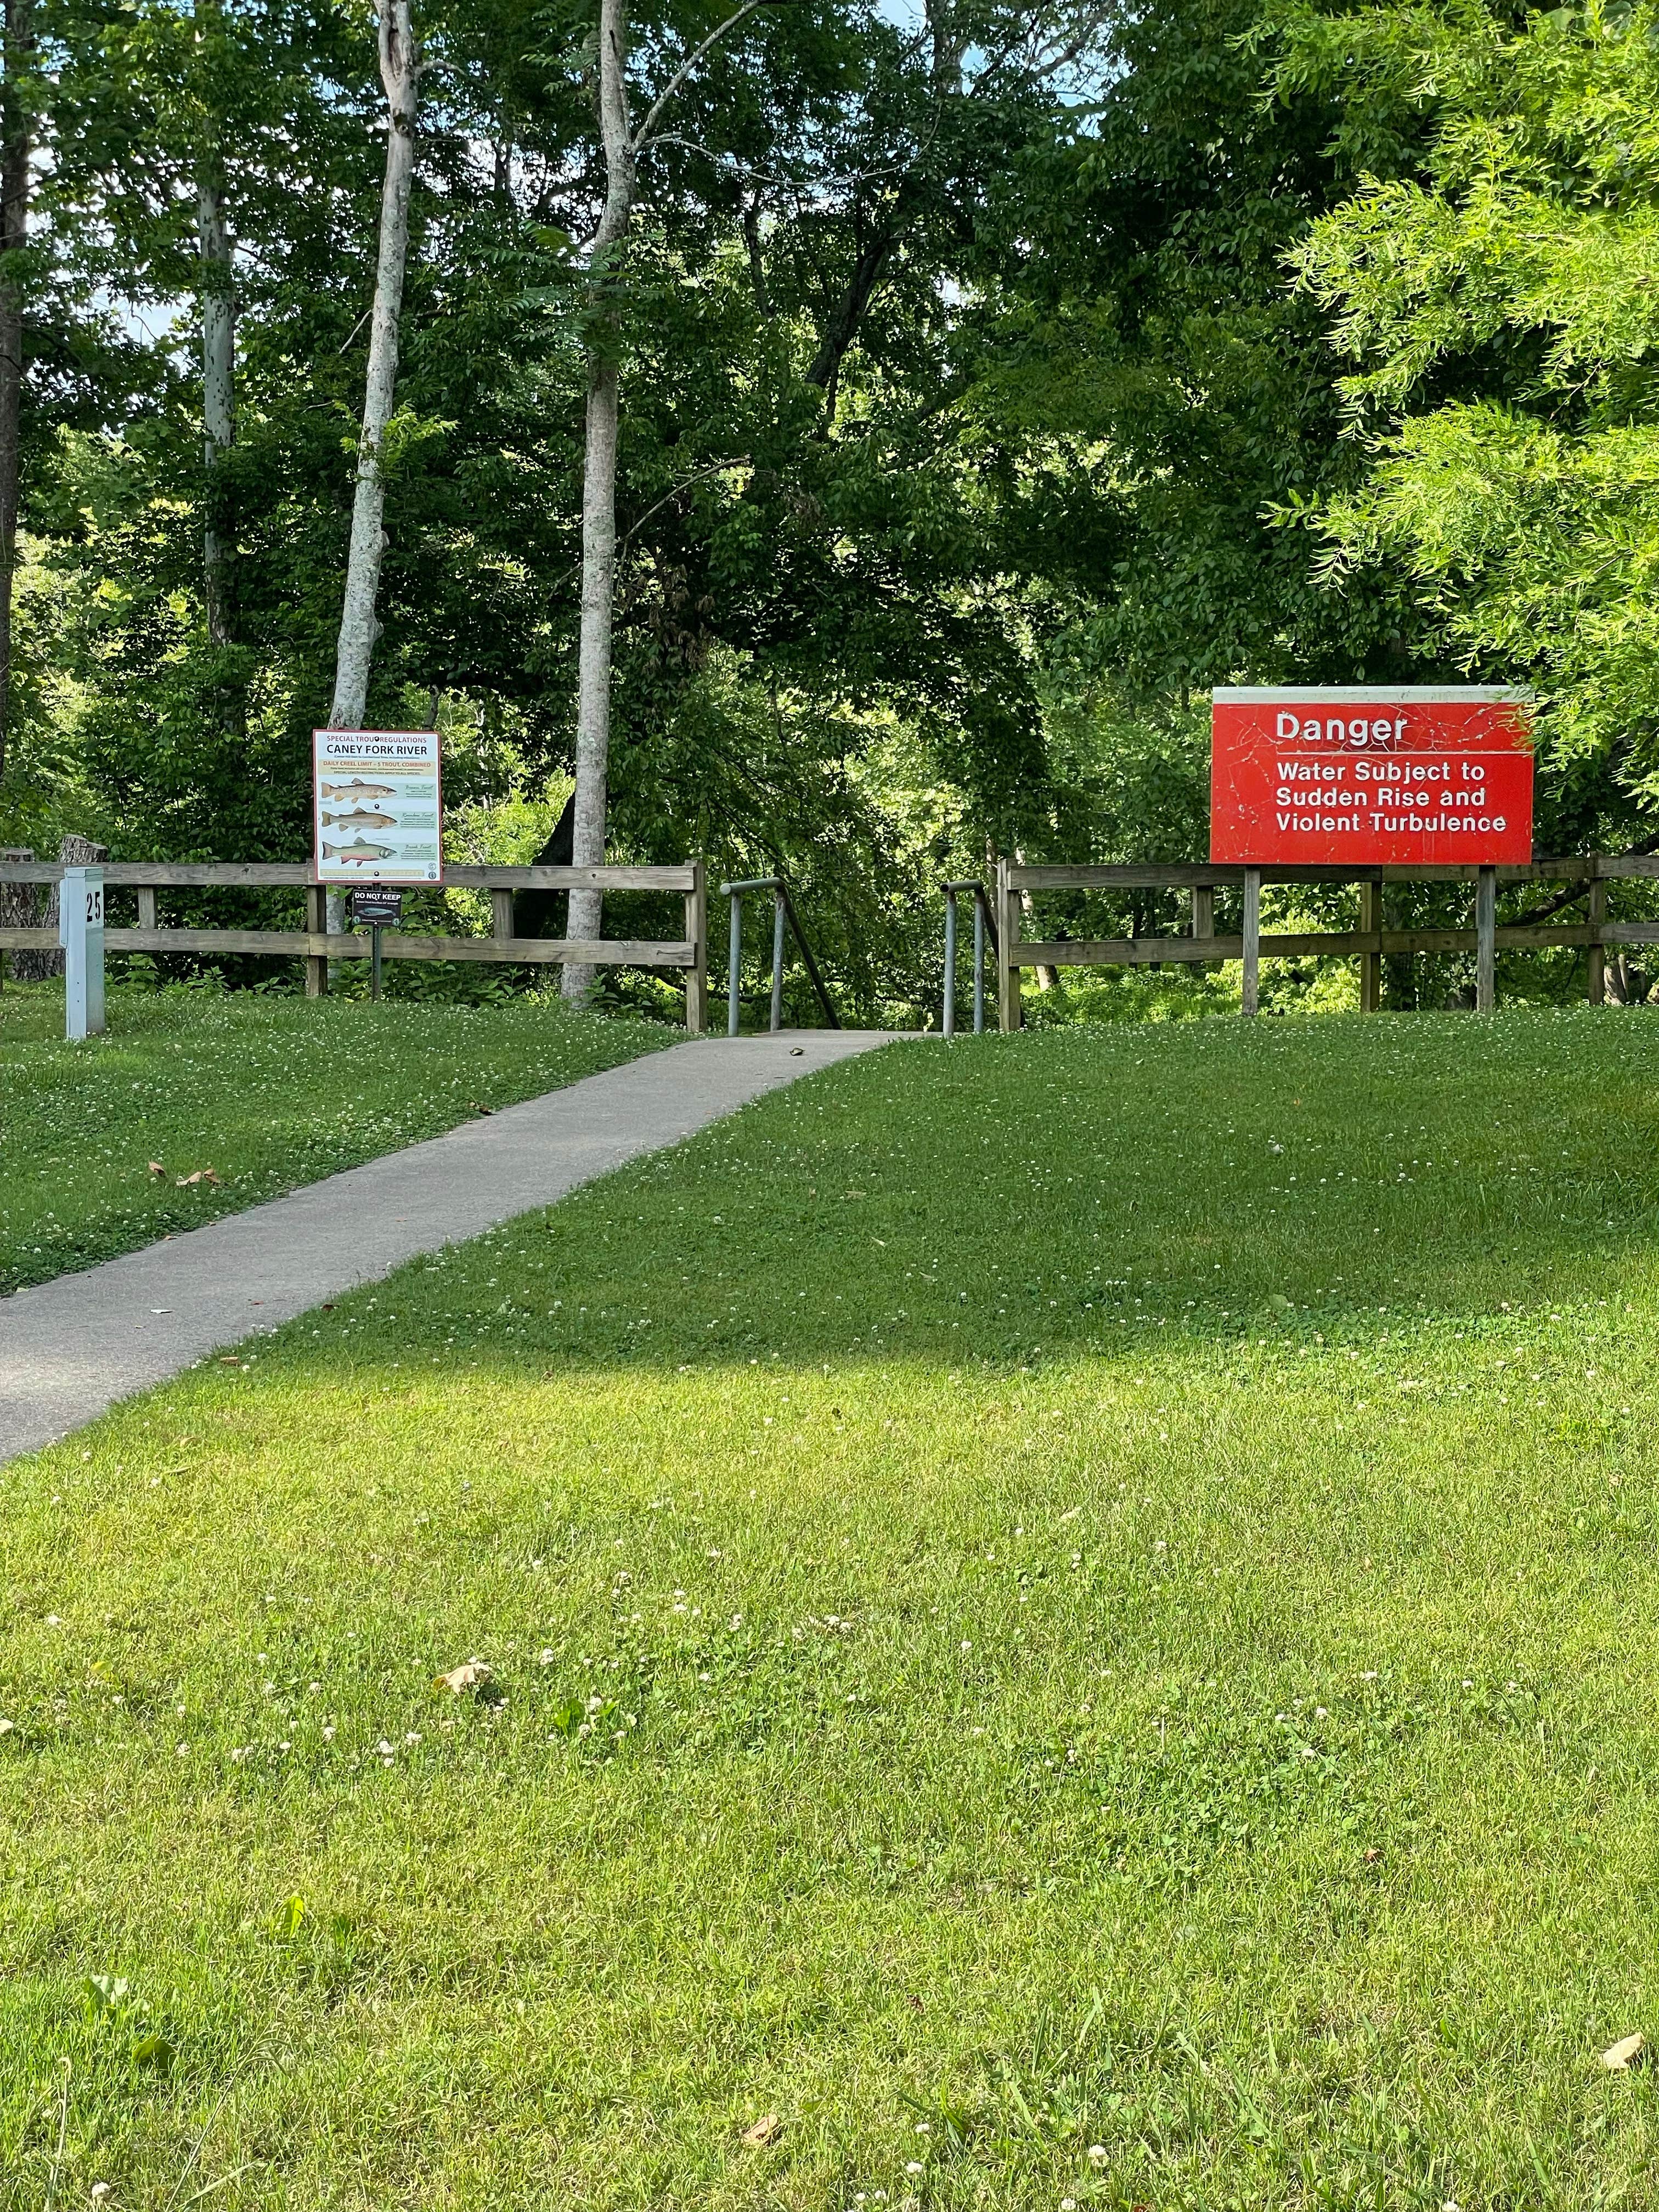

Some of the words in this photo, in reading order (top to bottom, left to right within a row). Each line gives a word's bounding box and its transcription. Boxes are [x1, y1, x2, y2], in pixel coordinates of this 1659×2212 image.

[1276, 712, 1407, 746] Danger
[327, 744, 363, 753] CANEY
[366, 745, 394, 754] FORK
[397, 746, 427, 754] RIVER
[1277, 762, 1346, 781] Water
[1355, 762, 1450, 785] Subject
[1461, 762, 1485, 781] to
[1276, 787, 1367, 807] Sudden
[1378, 787, 1430, 807] Rise
[1440, 787, 1485, 806] and
[1276, 812, 1360, 832] Violent
[1371, 812, 1506, 832] Turbulence
[87, 891, 100, 922] 25
